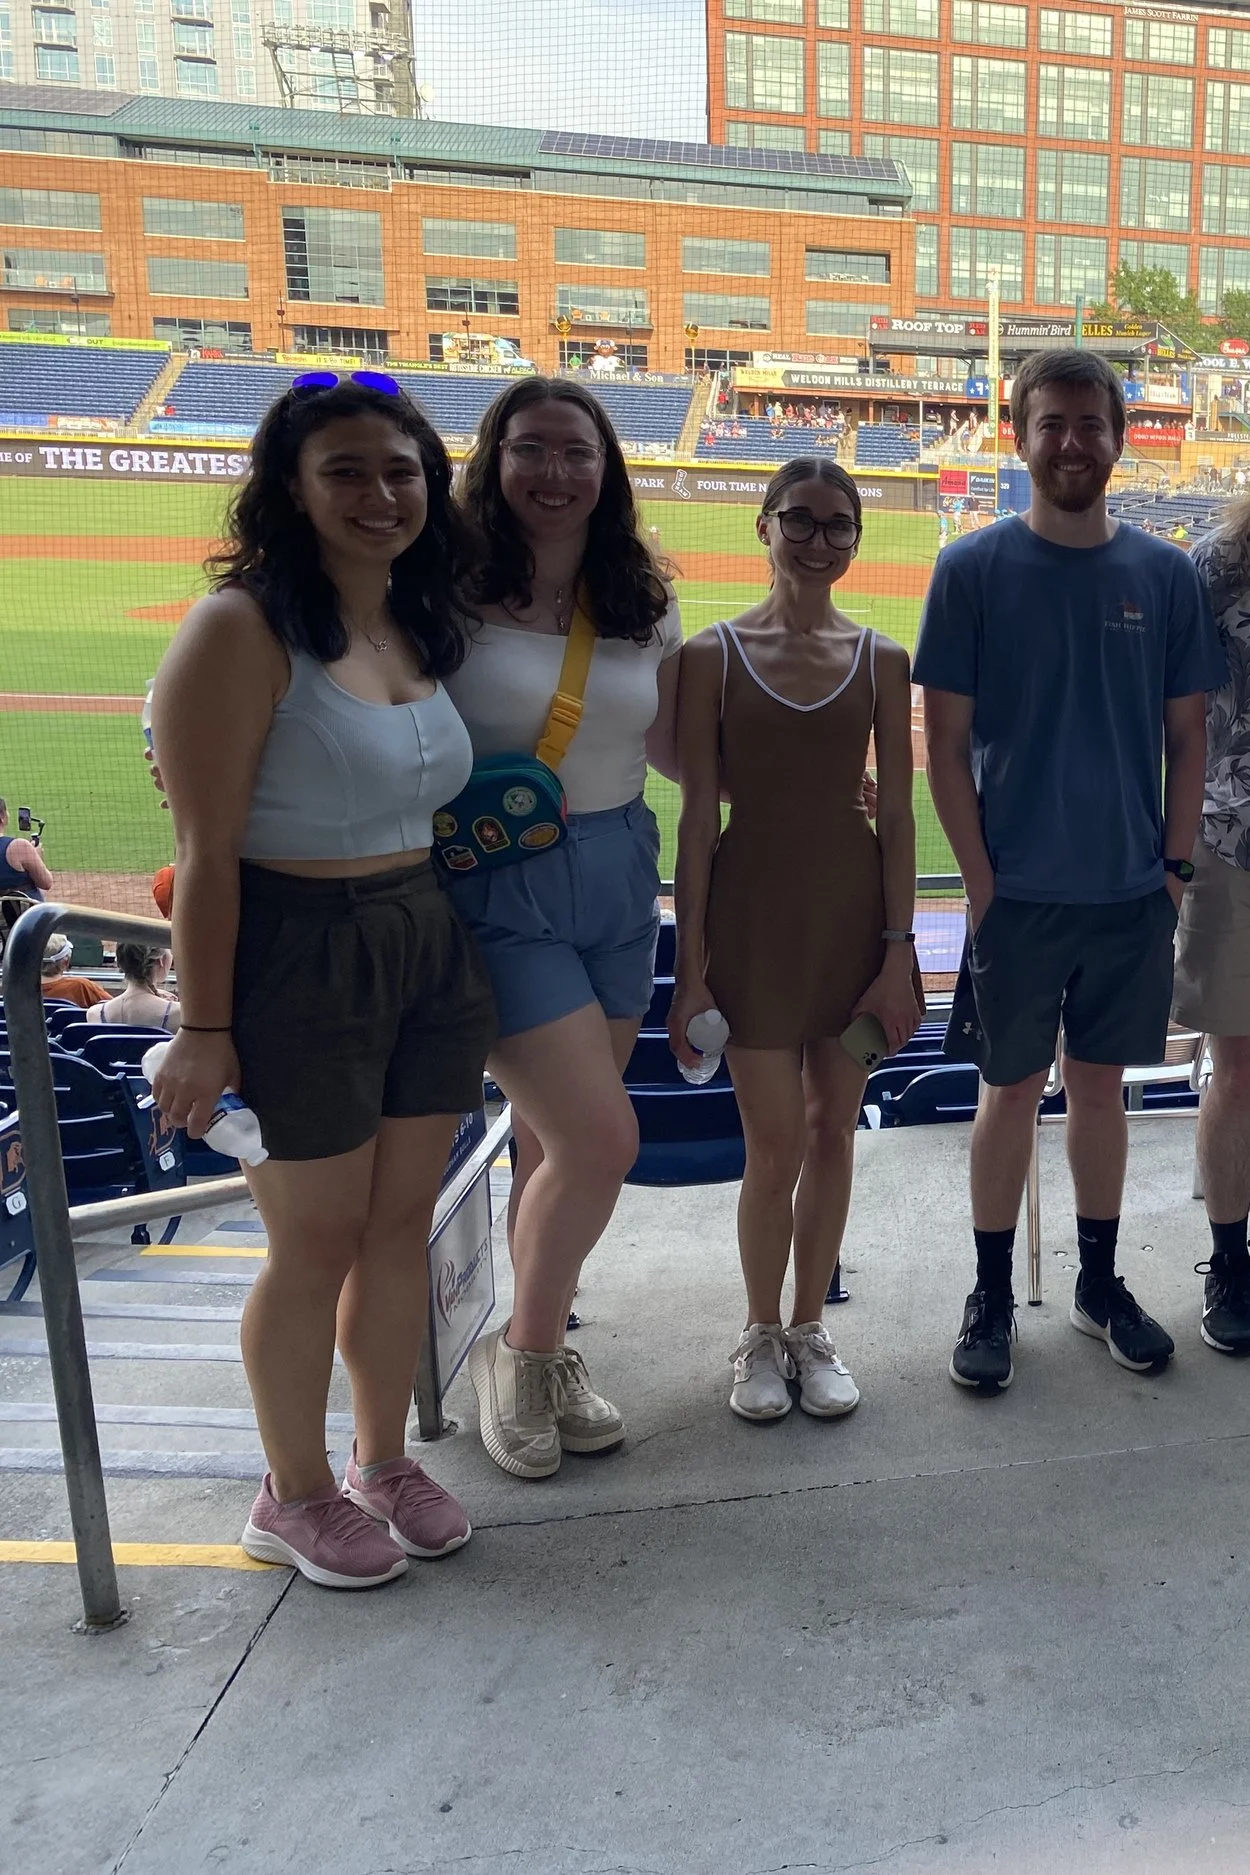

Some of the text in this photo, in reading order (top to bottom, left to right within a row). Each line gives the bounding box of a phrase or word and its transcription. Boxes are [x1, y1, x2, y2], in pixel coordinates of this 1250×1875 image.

[1124, 6, 1199, 22] JAMES SCOTT FARRIN
[891, 319, 964, 334] ROOF TOP
[1074, 324, 1113, 336] ELLES
[590, 370, 664, 382] Michael & Son
[791, 373, 964, 392] WELDON MILLS DISTILLERY TERRACE
[15, 453, 33, 464] OF
[39, 446, 103, 471] THE
[634, 477, 665, 489] PARK
[697, 480, 727, 491] FOUR
[727, 482, 756, 492] TIME
